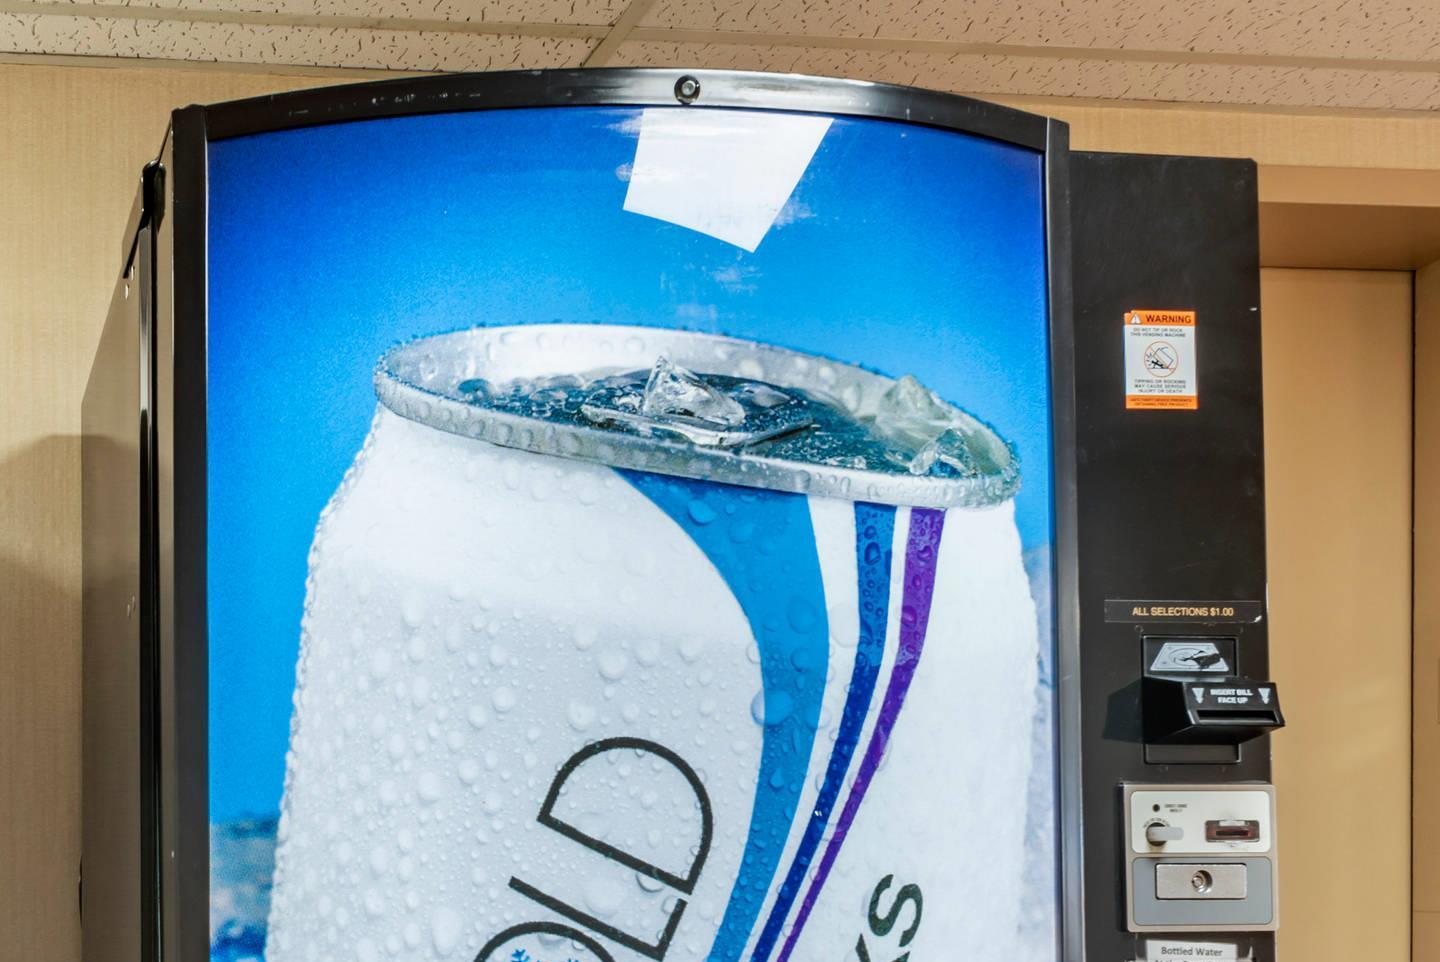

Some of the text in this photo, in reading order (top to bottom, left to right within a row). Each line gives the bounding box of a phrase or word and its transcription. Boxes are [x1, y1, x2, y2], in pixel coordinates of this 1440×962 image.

[1145, 314, 1192, 324] WARNING
[1132, 606, 1234, 617] ALL SELECTIONS $1.00
[1161, 946, 1223, 957] Bottled Water
